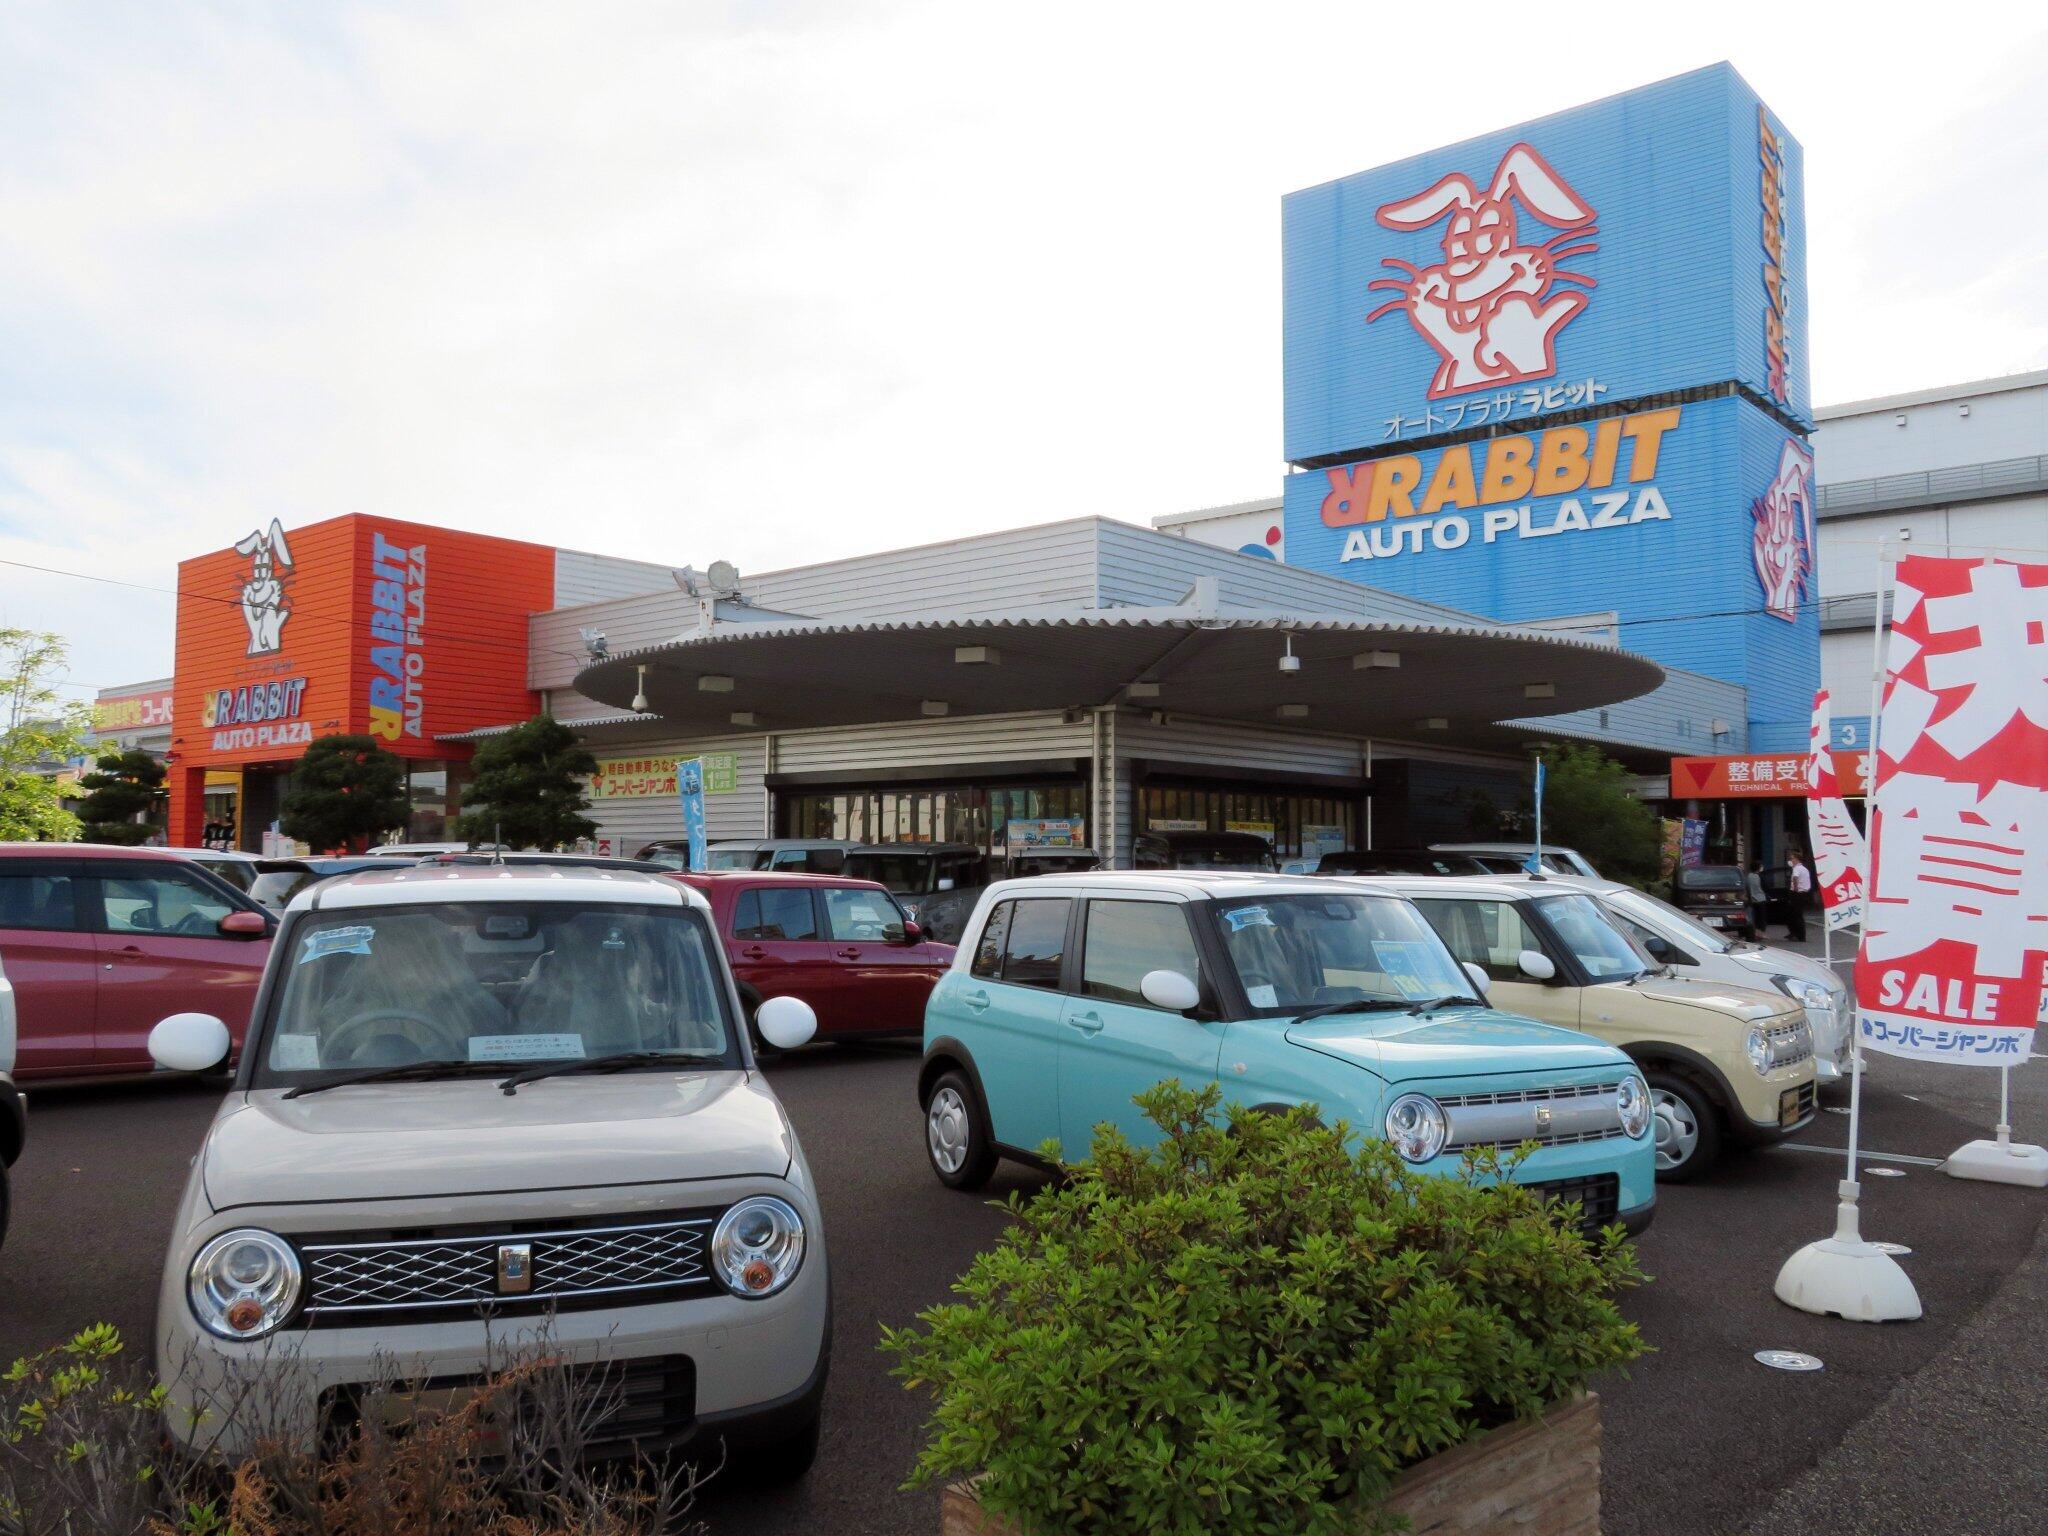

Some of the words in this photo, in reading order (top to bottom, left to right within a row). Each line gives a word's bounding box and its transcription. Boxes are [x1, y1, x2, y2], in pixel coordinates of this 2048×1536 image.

[1340, 515, 1470, 563] AUTO
[1483, 487, 1672, 543] PLAZA
[406, 544, 427, 646] PLAZA
[404, 652, 424, 738] AUTO
[212, 728, 254, 751] AUTO
[257, 721, 313, 747] PLAZA
[1842, 725, 1857, 745] 3
[1729, 784, 1783, 792] TECHNICAL
[1879, 969, 2001, 1021] SALE
